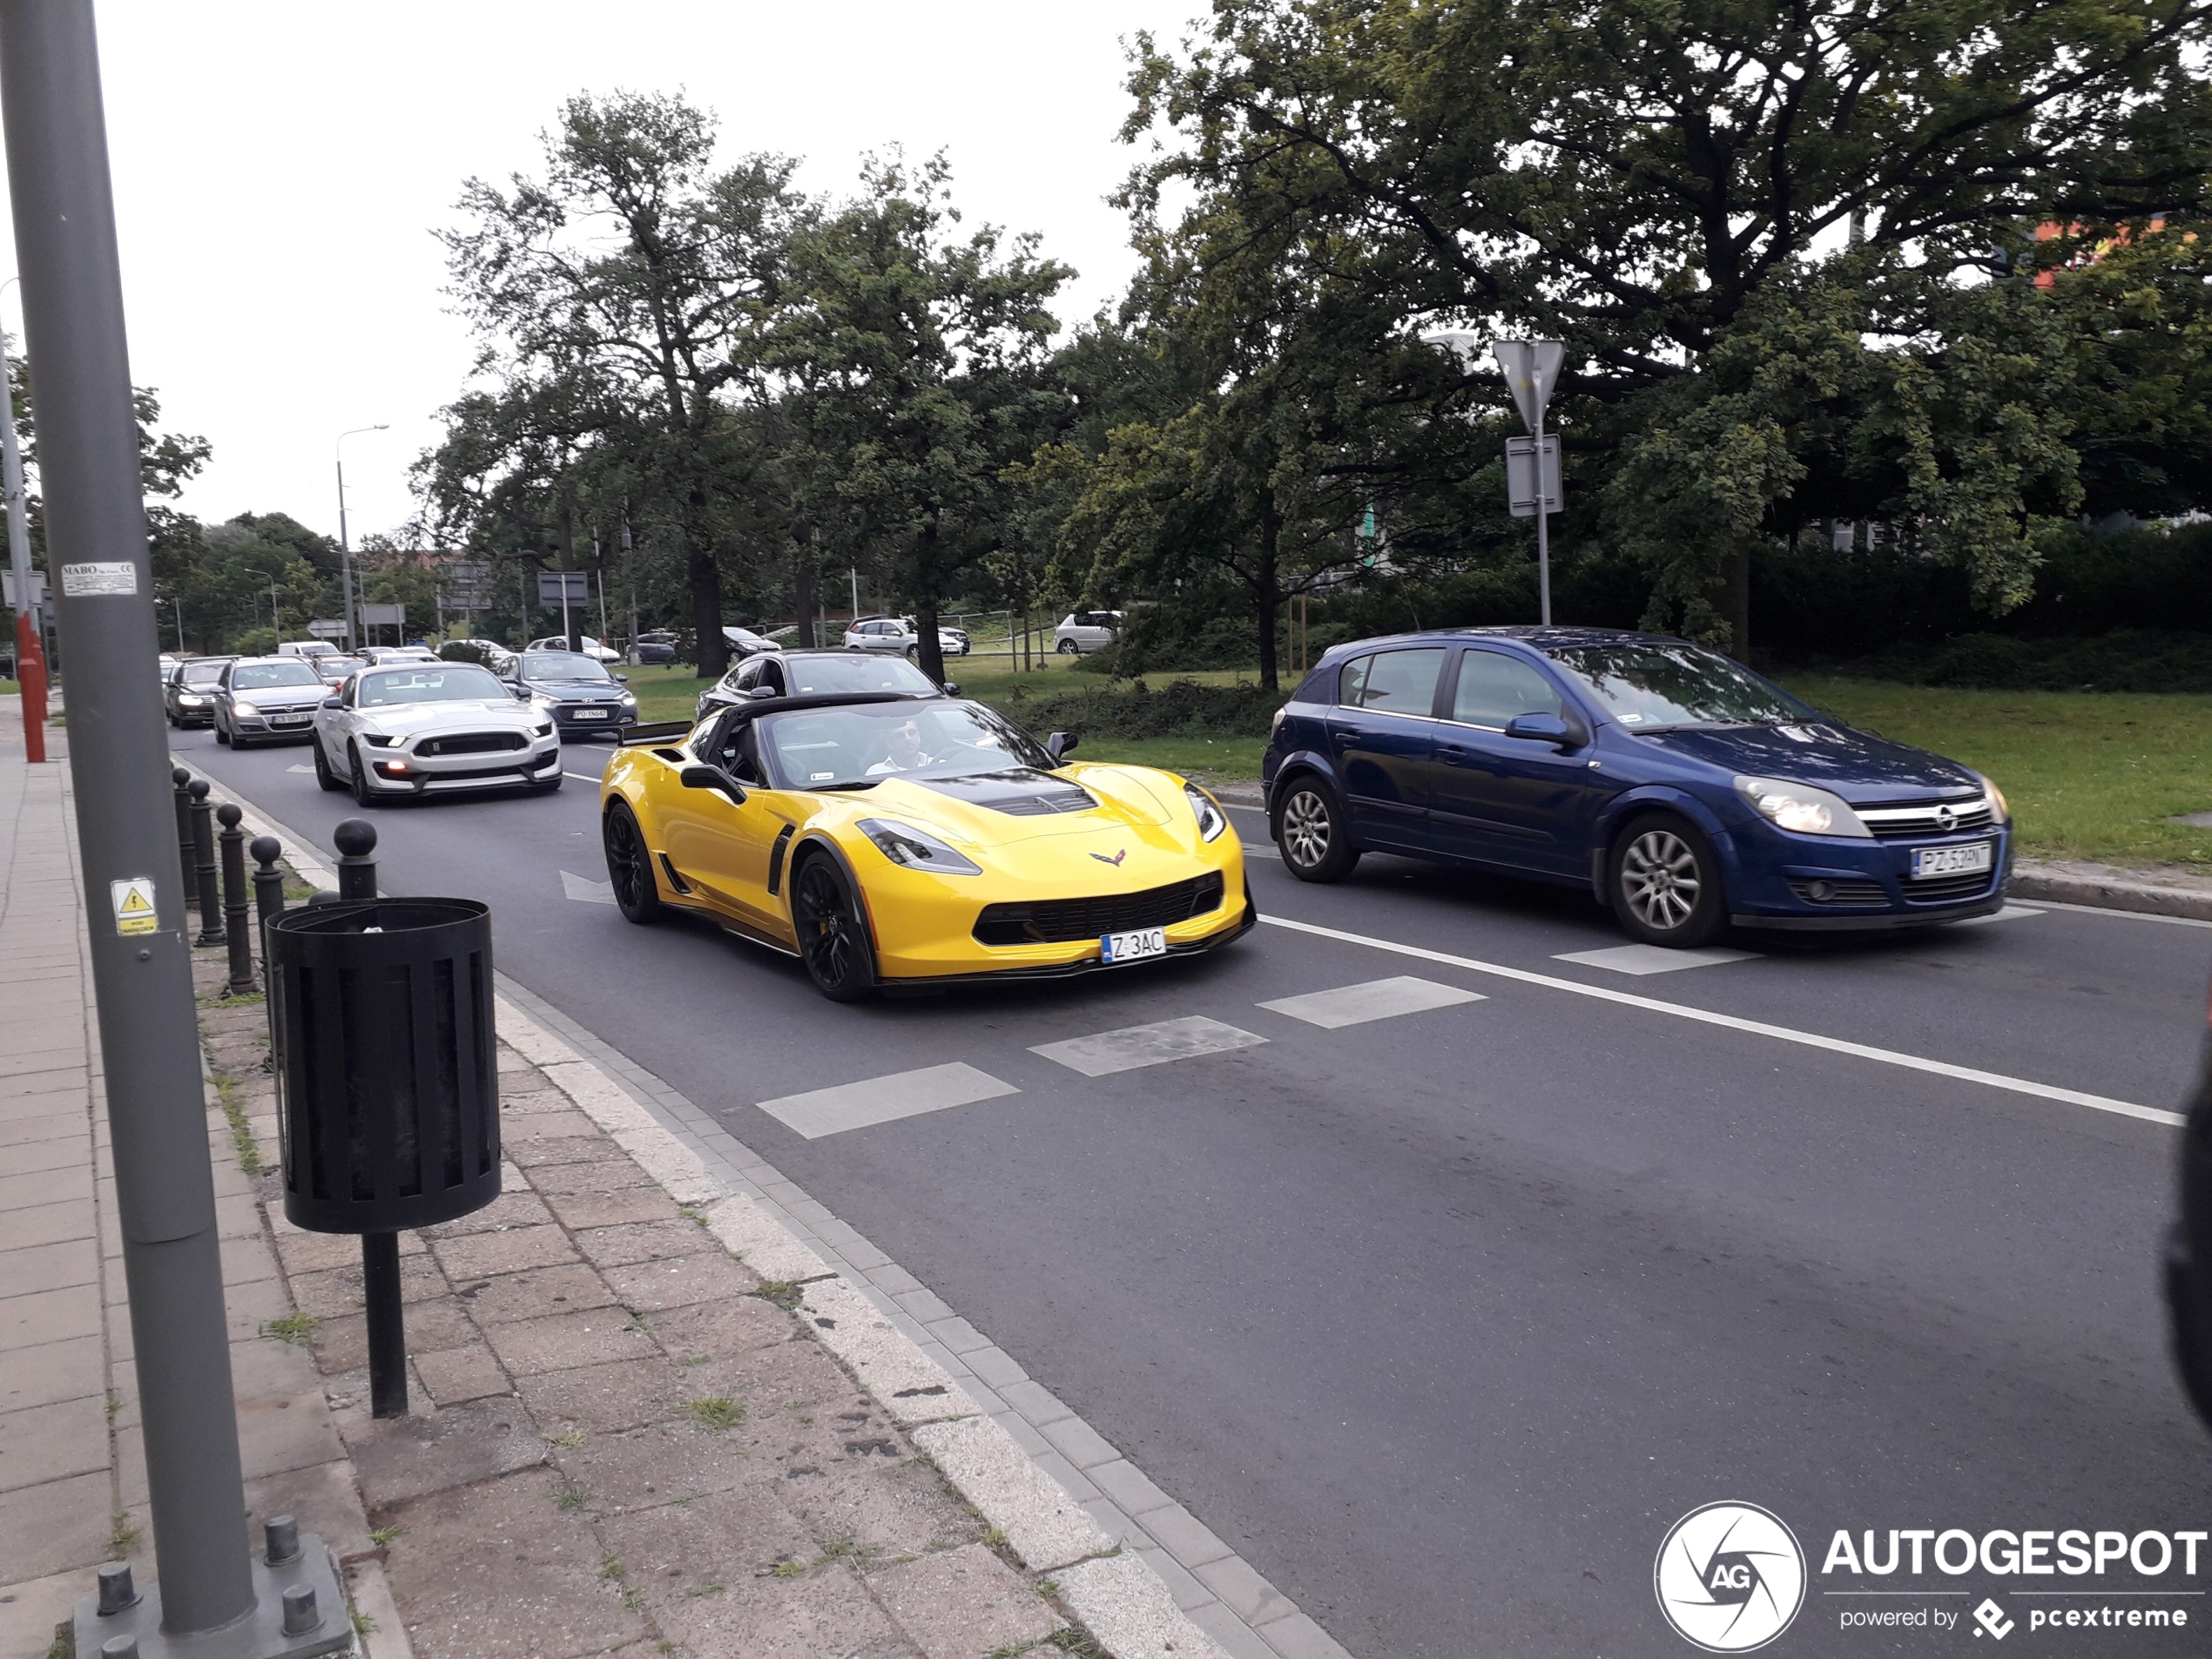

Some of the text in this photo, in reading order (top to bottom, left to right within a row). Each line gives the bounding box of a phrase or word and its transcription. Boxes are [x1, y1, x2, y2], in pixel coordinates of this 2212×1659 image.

[63, 564, 97, 575] MABO
[1112, 931, 1163, 958] Z 3AC
